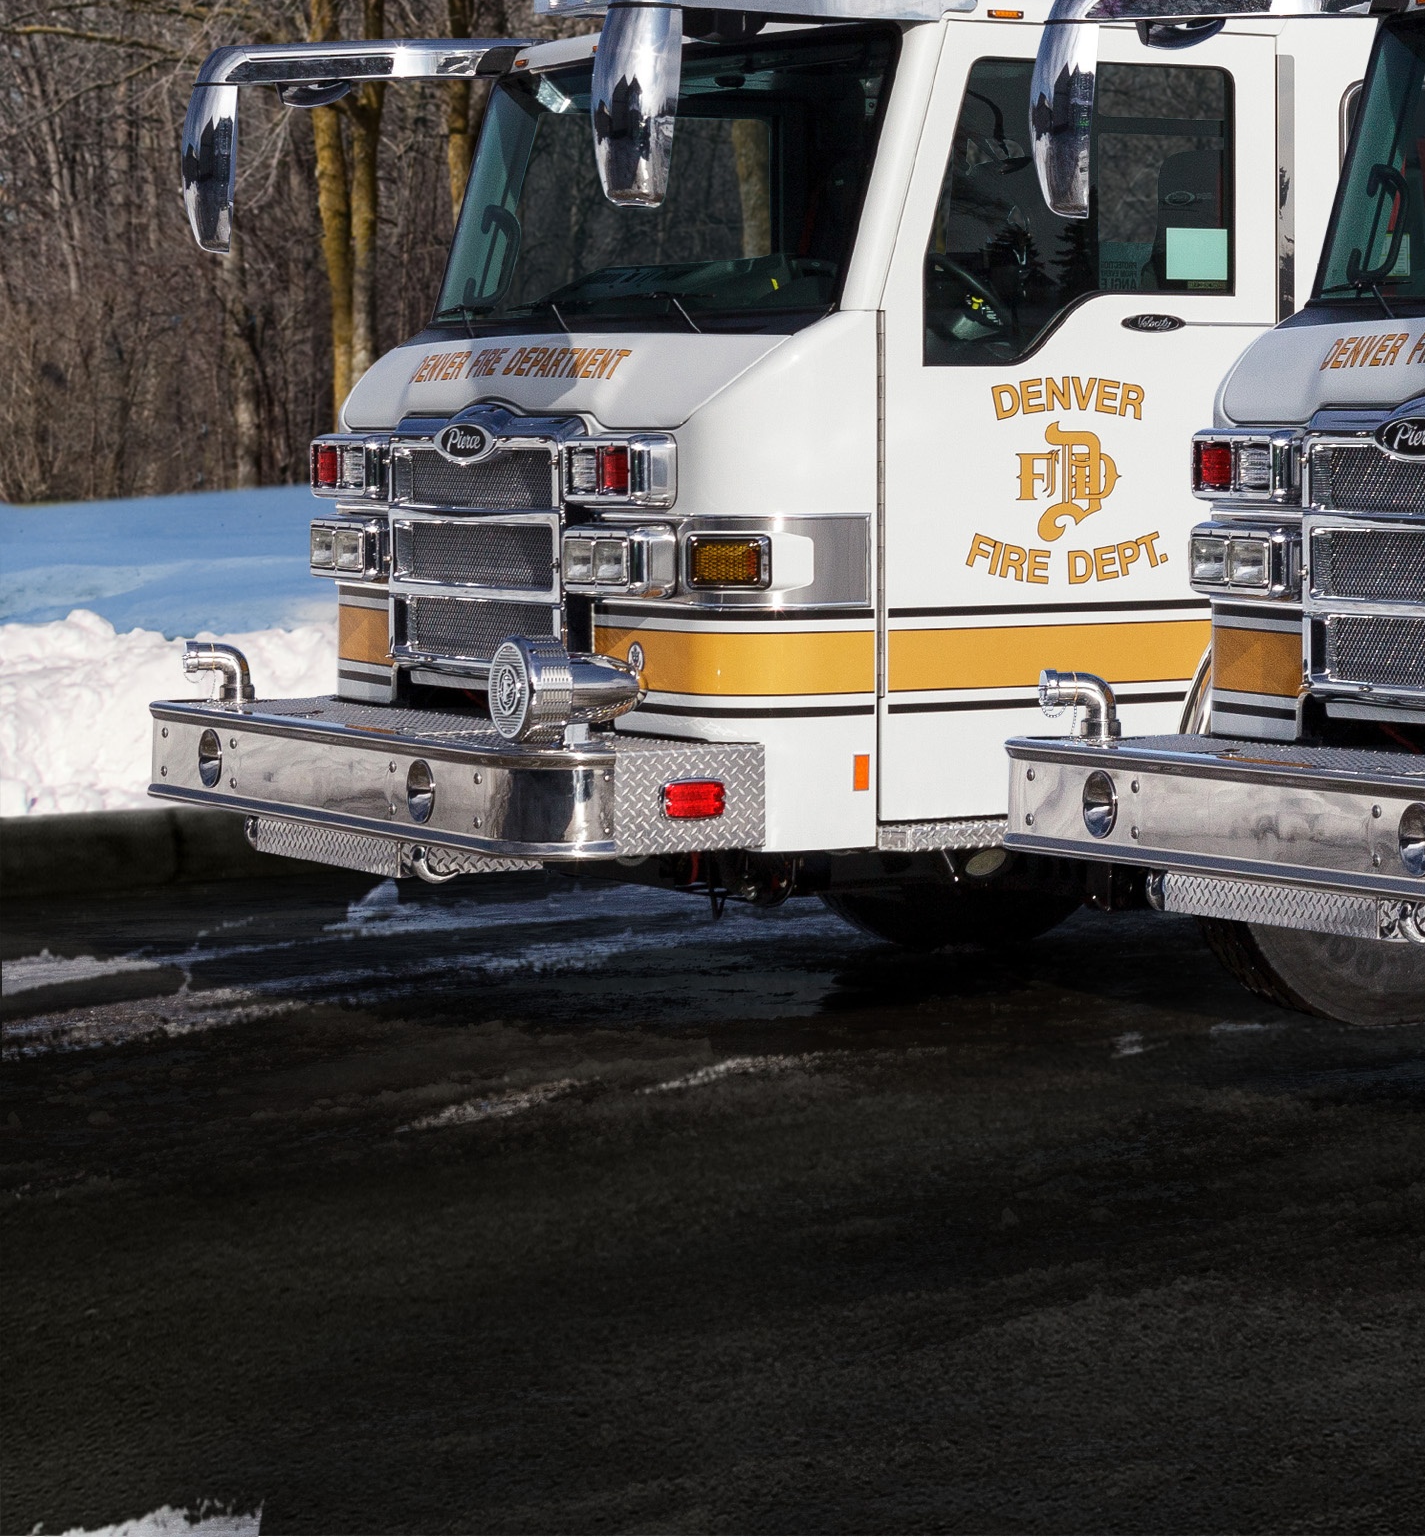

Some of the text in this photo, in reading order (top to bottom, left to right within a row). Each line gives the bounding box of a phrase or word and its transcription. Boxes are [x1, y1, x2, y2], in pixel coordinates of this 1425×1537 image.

[409, 347, 632, 385] DENVER FIRE DEPARTMENT
[1320, 333, 1409, 371] DENVER
[991, 376, 1145, 421] DENVER
[447, 428, 481, 452] Pierce
[965, 531, 1168, 584] FIRE DEPT.
